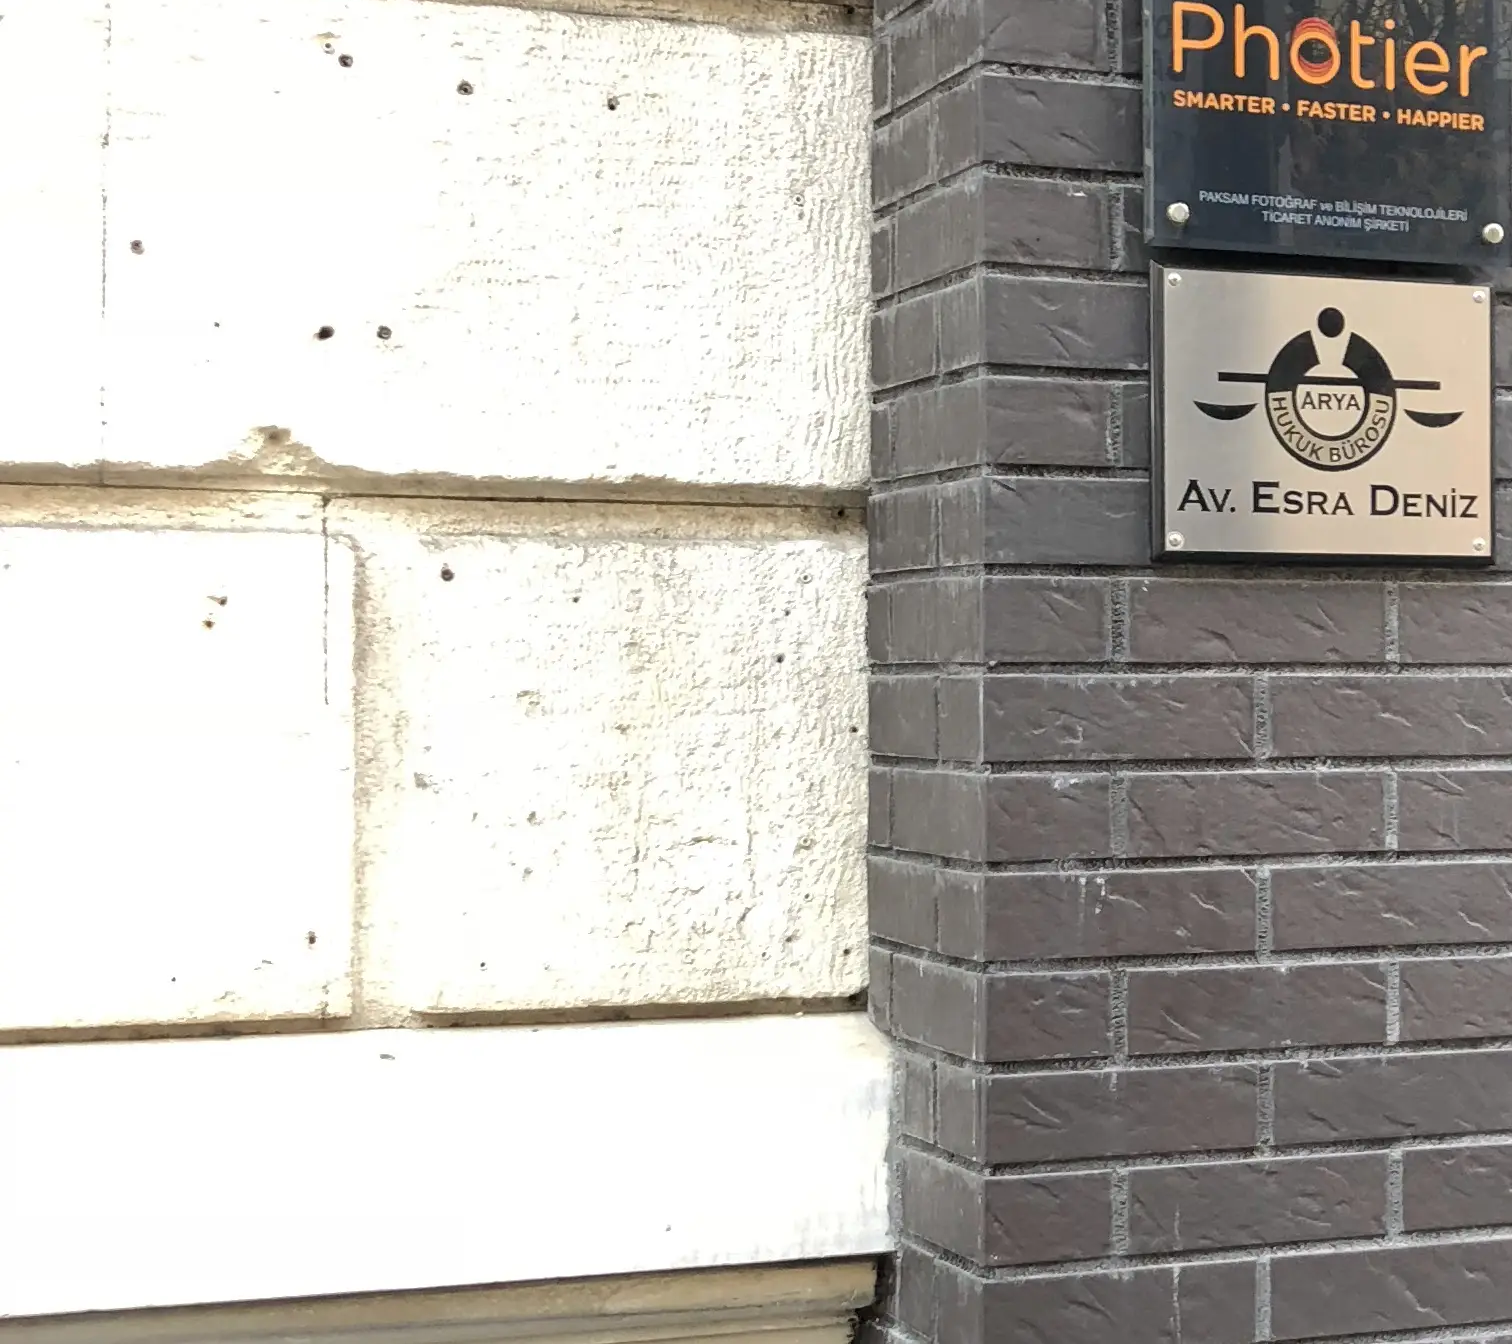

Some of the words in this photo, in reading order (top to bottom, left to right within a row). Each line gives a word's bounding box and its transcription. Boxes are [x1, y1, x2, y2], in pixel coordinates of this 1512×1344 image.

[1171, 0, 1488, 97] Photier
[1172, 89, 1276, 115] SMARTER
[1296, 99, 1377, 123] FASTER
[1396, 108, 1485, 132] HAPPIER
[1199, 190, 1249, 205] PAKSAM
[1251, 194, 1318, 210] FOTOĞRAF
[1262, 209, 1313, 225] TİCARET
[1301, 390, 1361, 411] ARYA
[1271, 396, 1324, 461] HUKUK
[1328, 399, 1390, 463] BÜROSU
